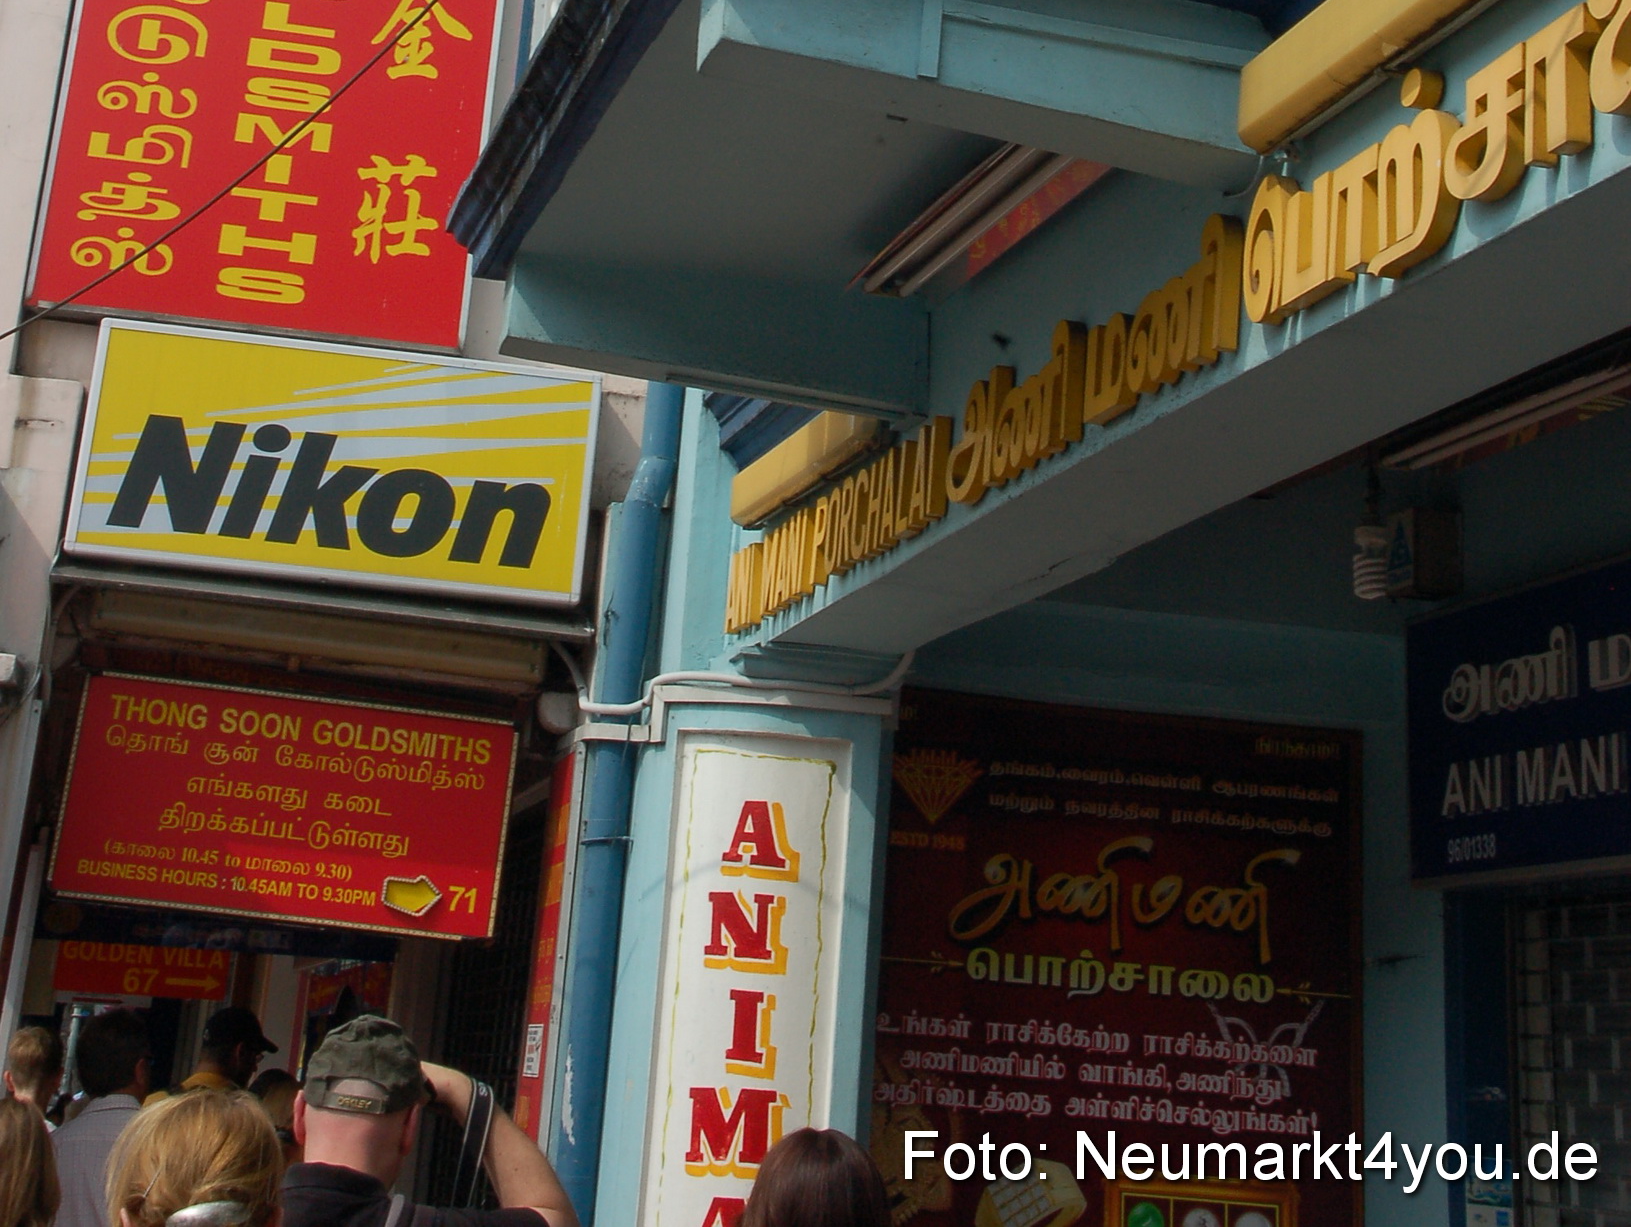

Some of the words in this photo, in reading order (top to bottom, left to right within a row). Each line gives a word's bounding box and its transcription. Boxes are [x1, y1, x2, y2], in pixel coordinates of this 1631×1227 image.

[107, 413, 553, 570] Nikon
[724, 542, 765, 635] ANI
[761, 506, 818, 618] MANI
[810, 415, 954, 587] PORCHALAI
[1443, 624, 1578, 724] அணி
[105, 723, 190, 755] தொங்
[111, 693, 209, 730] THONG
[219, 707, 302, 742] SOON
[312, 718, 492, 765] GOLDSMITHS
[186, 772, 309, 811] எங்களது
[322, 790, 393, 817] கடை
[1441, 753, 1502, 816] ANI
[1516, 732, 1621, 806] MANI
[157, 800, 410, 859] திறக்கப்பட்டுள்ளது
[76, 858, 158, 882] BUSINESS
[160, 869, 218, 889] HOURS
[230, 876, 292, 898] 10.45AM
[295, 883, 320, 901] TO
[321, 883, 378, 907] 9.30PM
[180, 846, 219, 867] 10.45
[223, 852, 241, 868] to
[244, 856, 311, 876] மாலை
[314, 861, 353, 882] 9.30)
[447, 884, 479, 915] 71
[62, 939, 155, 965] GOLDEN
[163, 947, 225, 970] VILLA
[965, 946, 1275, 1004] பொற்சாலை
[122, 967, 160, 993] 67
[875, 1009, 972, 1039] உங்கள்
[900, 1046, 1067, 1080] அணிமணியில்
